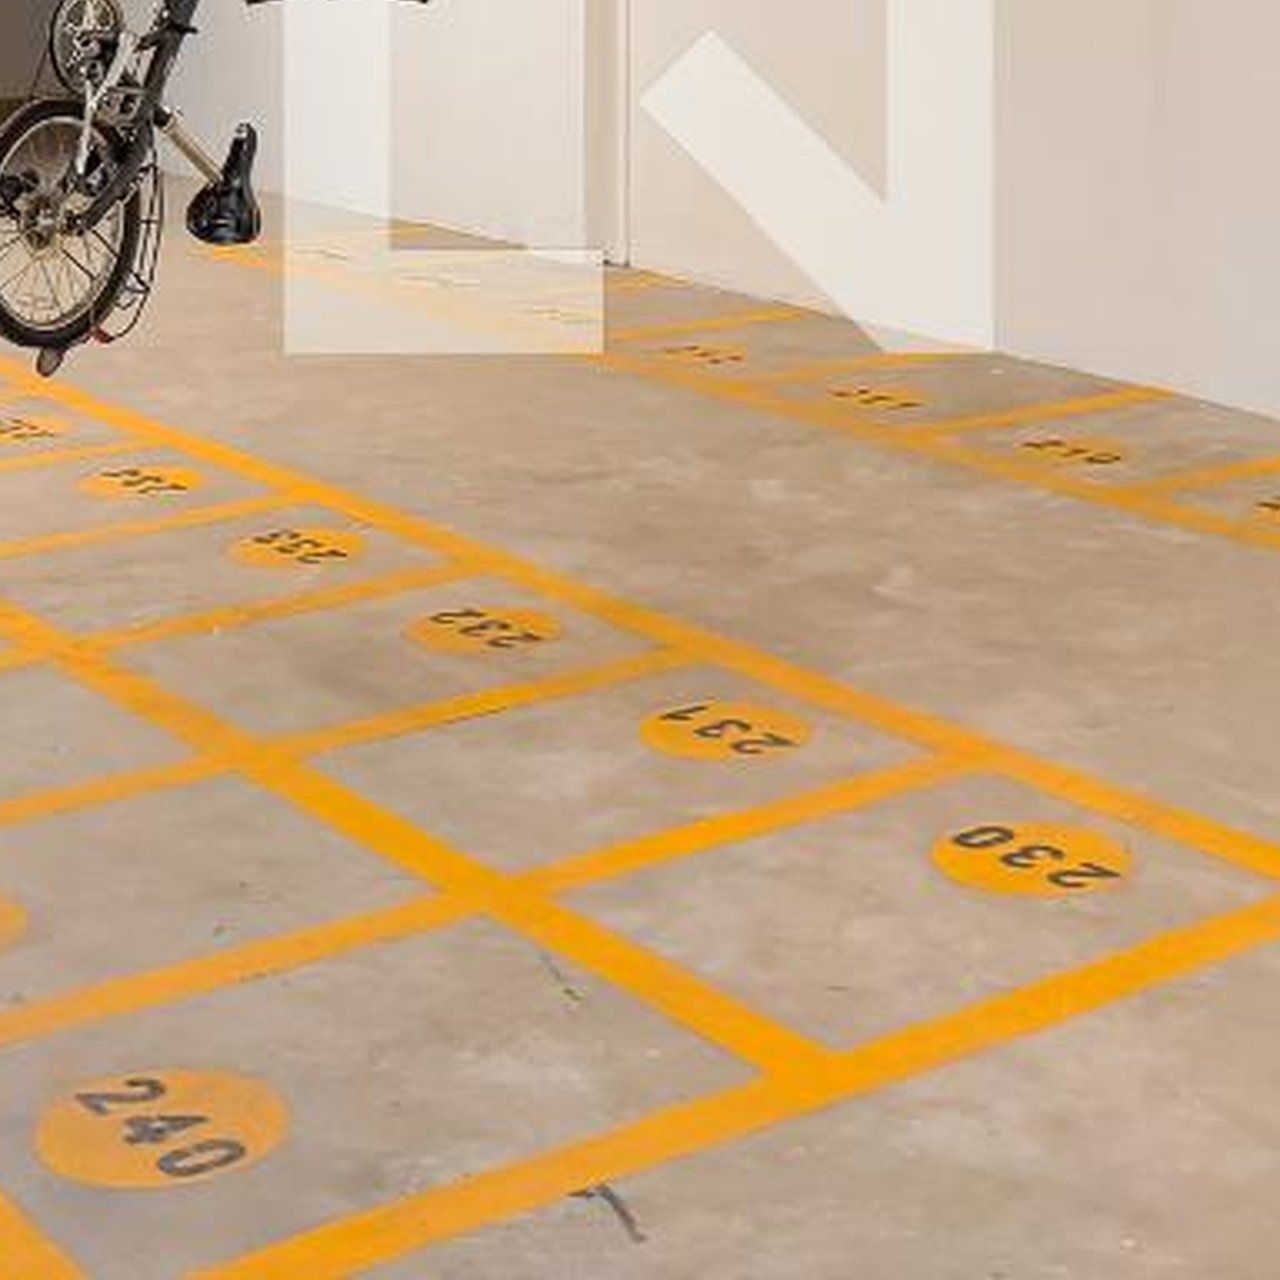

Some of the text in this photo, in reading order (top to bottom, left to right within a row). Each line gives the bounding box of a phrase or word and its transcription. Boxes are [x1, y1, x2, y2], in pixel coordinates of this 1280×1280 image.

[428, 608, 544, 650] 232
[658, 701, 798, 755] 231
[950, 825, 1122, 889] 230
[73, 1077, 247, 1178] 240
